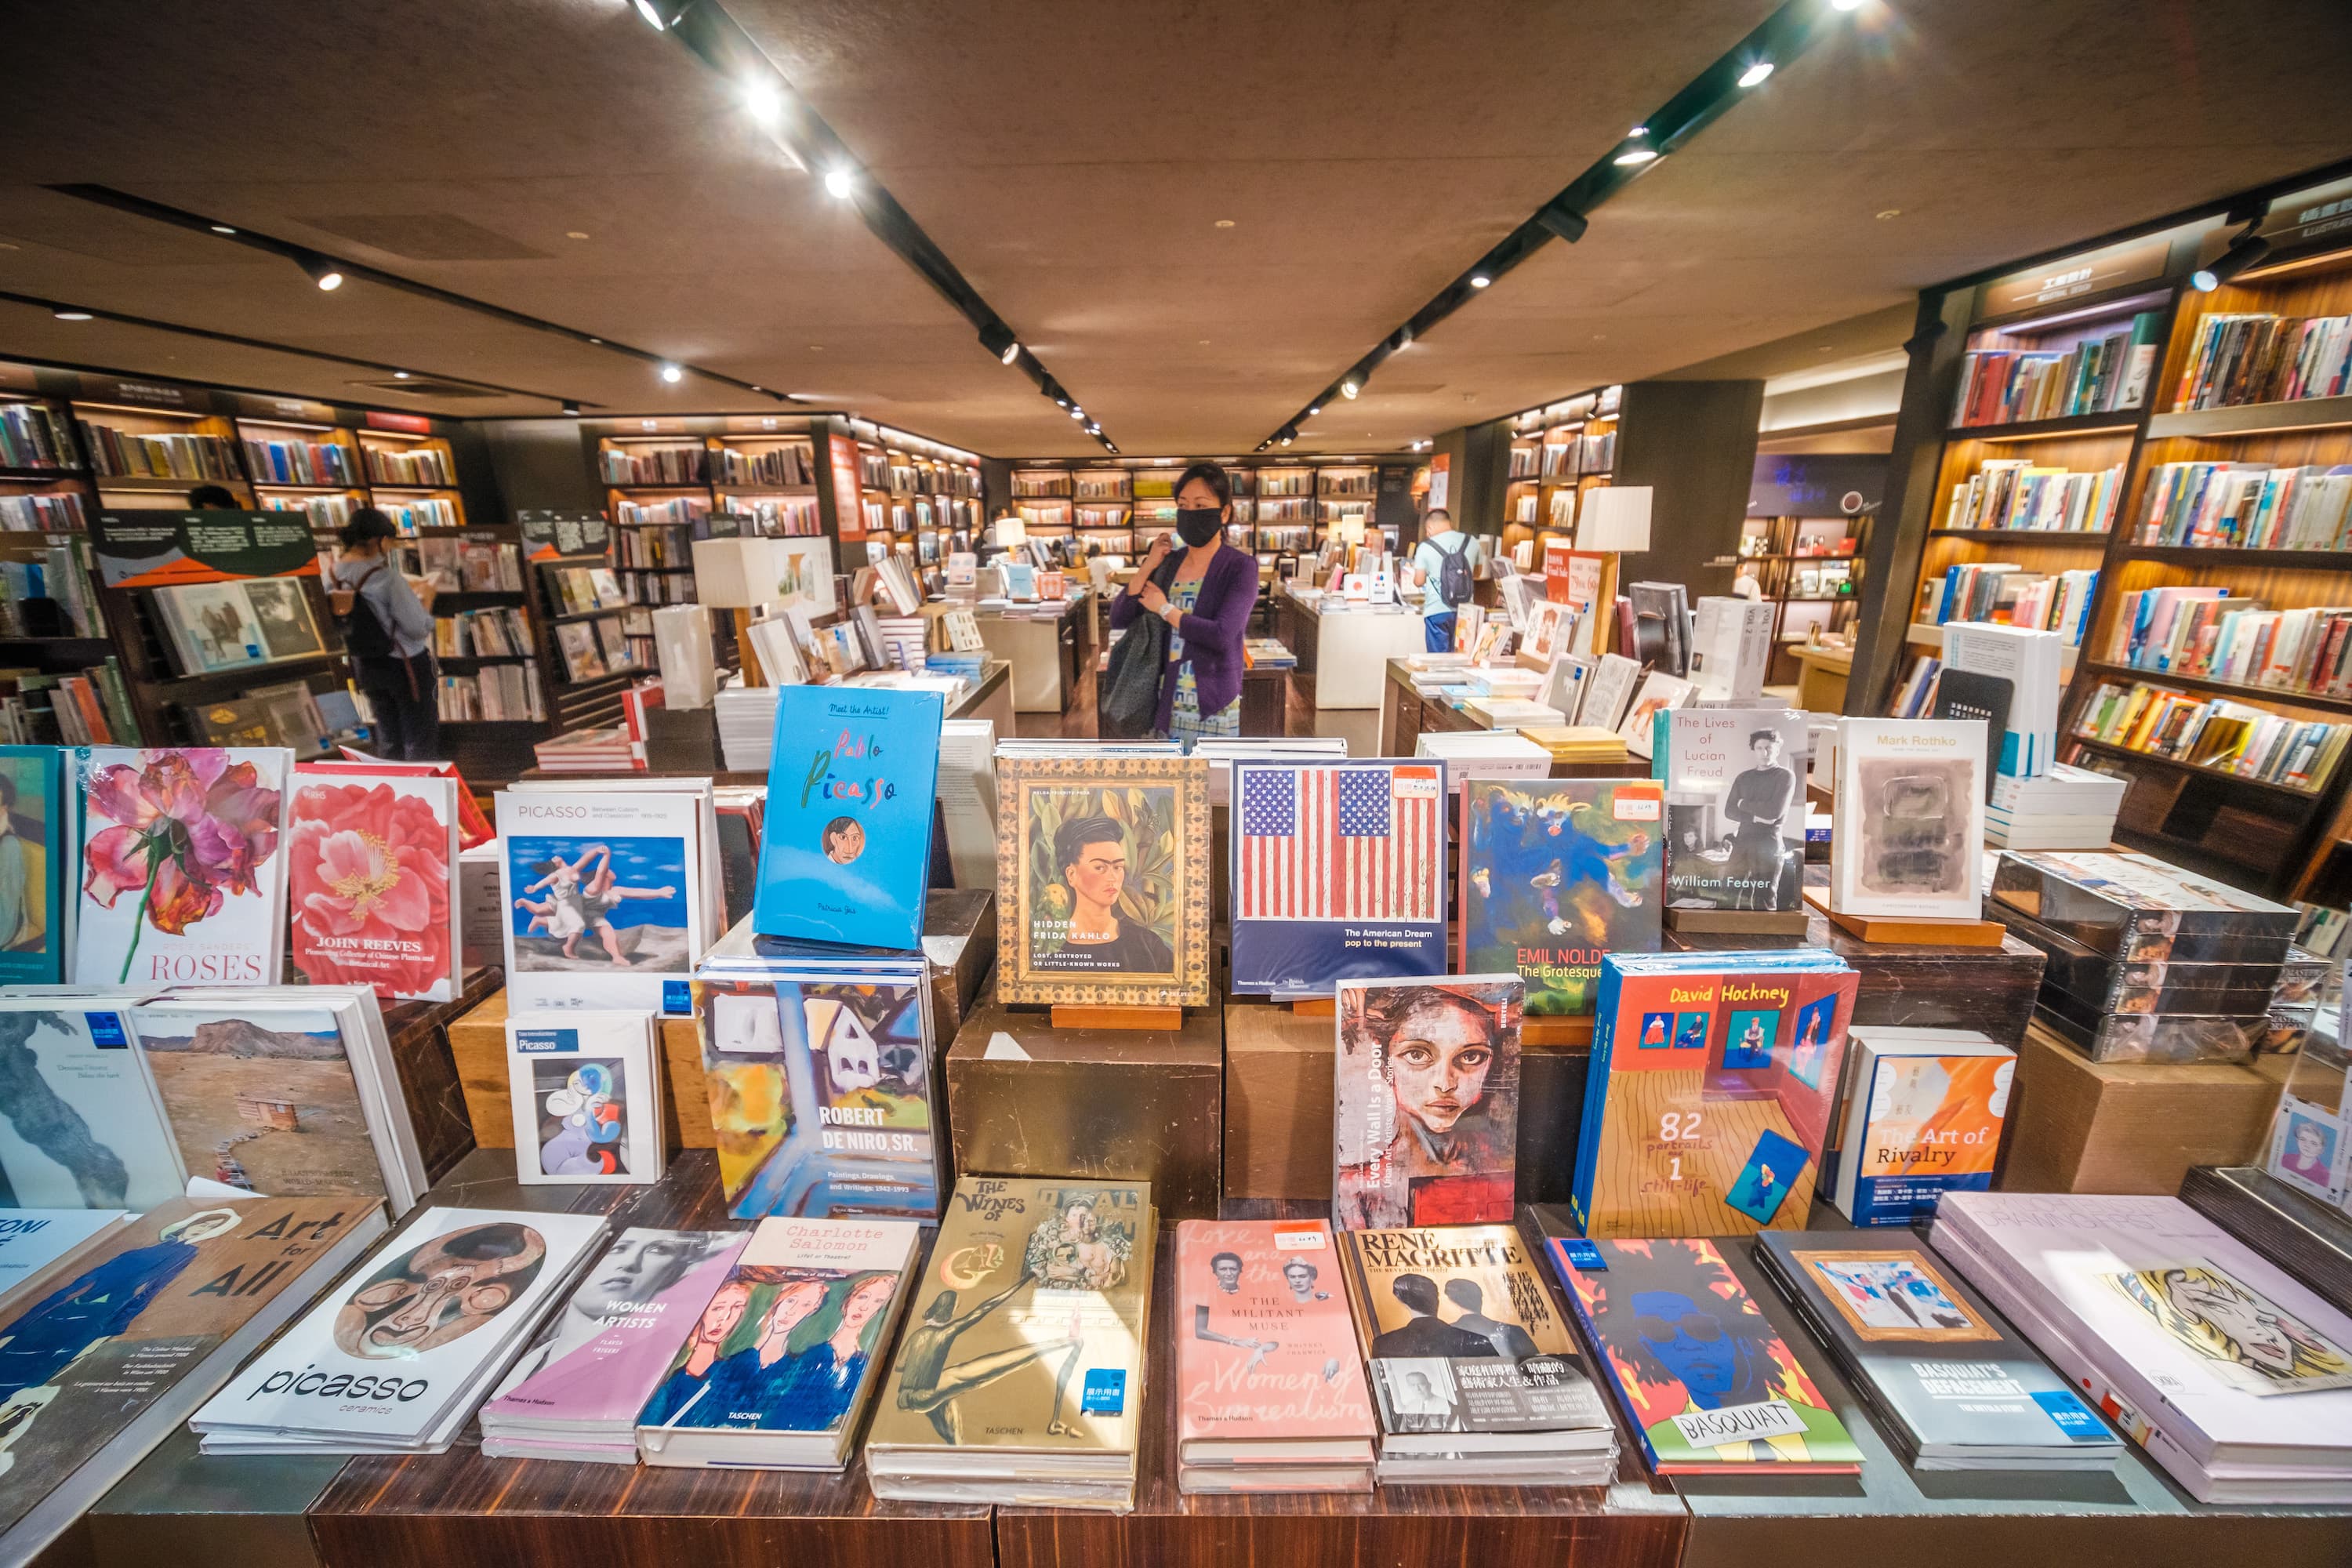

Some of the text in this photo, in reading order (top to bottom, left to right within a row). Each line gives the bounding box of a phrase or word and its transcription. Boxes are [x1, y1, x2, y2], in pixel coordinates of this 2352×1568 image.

[1747, 608, 1756, 624] VOL
[829, 703, 889, 715] Meet the Artist!
[1677, 717, 1735, 728] The Lives
[833, 728, 884, 760] Pablo
[1700, 734, 1711, 744] of
[1877, 735, 1957, 746] Mark Rothko
[1686, 750, 1726, 760] Lucian
[801, 750, 897, 810] Picasso
[1687, 766, 1723, 778] Freud
[519, 806, 586, 818] PICASSO
[1671, 875, 1771, 888] William Feaver
[1345, 929, 1361, 938] The
[1363, 929, 1403, 938] American
[317, 937, 421, 953] JOHN REEVES
[1517, 949, 1555, 964] EMIL
[150, 954, 261, 981] ROSES
[1517, 965, 1540, 978] The
[1670, 982, 1790, 1009] David Hockney
[519, 1040, 556, 1051] Picasso
[818, 1106, 884, 1126] ROBERT
[1367, 1042, 1383, 1189] Every Wall Is a Door
[1660, 1112, 1701, 1142] 82
[822, 1131, 918, 1152] DE NIRO, SR.
[1881, 1127, 1990, 1145] The Art of
[1646, 1139, 1712, 1159] portraits
[1876, 1146, 1958, 1167] Rivalry
[1670, 1157, 1682, 1181] 1
[975, 1181, 1008, 1194] THE
[1641, 1178, 1711, 1197] still-life
[985, 1210, 1001, 1222] OF
[242, 1211, 345, 1240] Art
[786, 1225, 884, 1239] Charlotte
[789, 1239, 868, 1250] Salomon
[1359, 1229, 1439, 1250] RENÉ
[281, 1243, 313, 1256] for
[1363, 1246, 1522, 1268] MAGRITTE
[187, 1261, 294, 1297] All
[1245, 1263, 1282, 1283] the
[605, 1300, 667, 1314] WOMEN
[1232, 1309, 1305, 1318] MILITANT
[592, 1316, 657, 1329] ARTISTS
[1214, 1352, 1362, 1403] Women of
[1910, 1363, 2008, 1379] BASQUIAT'S
[245, 1364, 429, 1402] picasso
[1919, 1379, 2026, 1395] DEFACEMENT
[339, 1403, 393, 1414] ceramics
[1679, 1404, 1788, 1439] BASQUIAT
[985, 1426, 1023, 1436] TASCHEN
